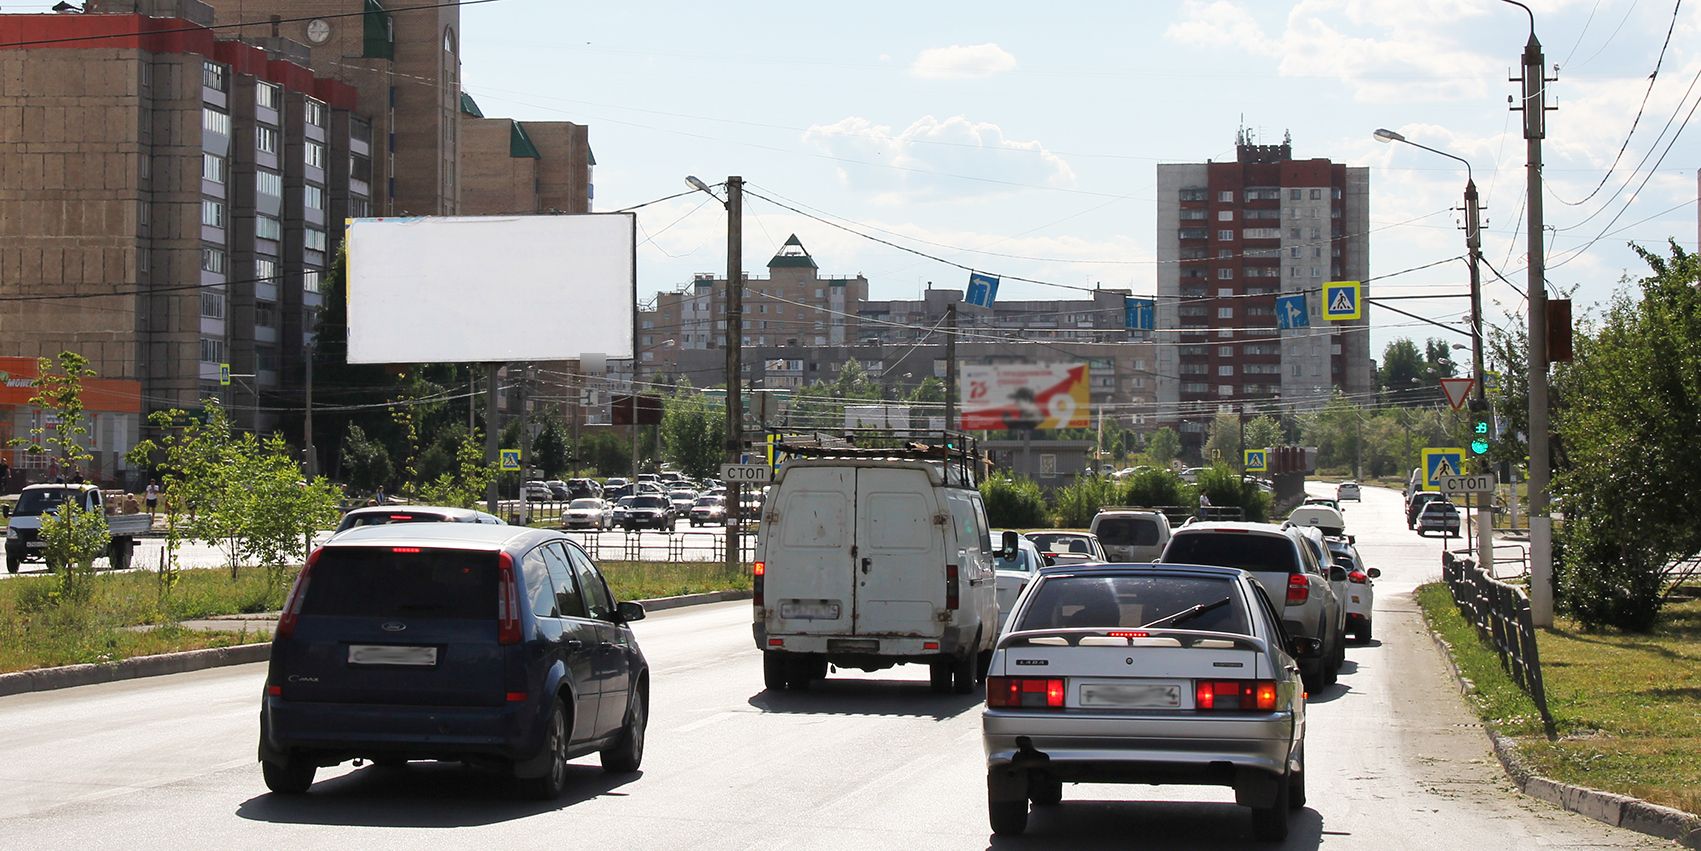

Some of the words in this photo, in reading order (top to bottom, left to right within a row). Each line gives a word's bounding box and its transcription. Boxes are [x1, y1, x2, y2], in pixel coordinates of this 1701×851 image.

[1048, 393, 1076, 428] 9
[727, 467, 764, 479] СТОП
[1447, 478, 1487, 490] СТОП
